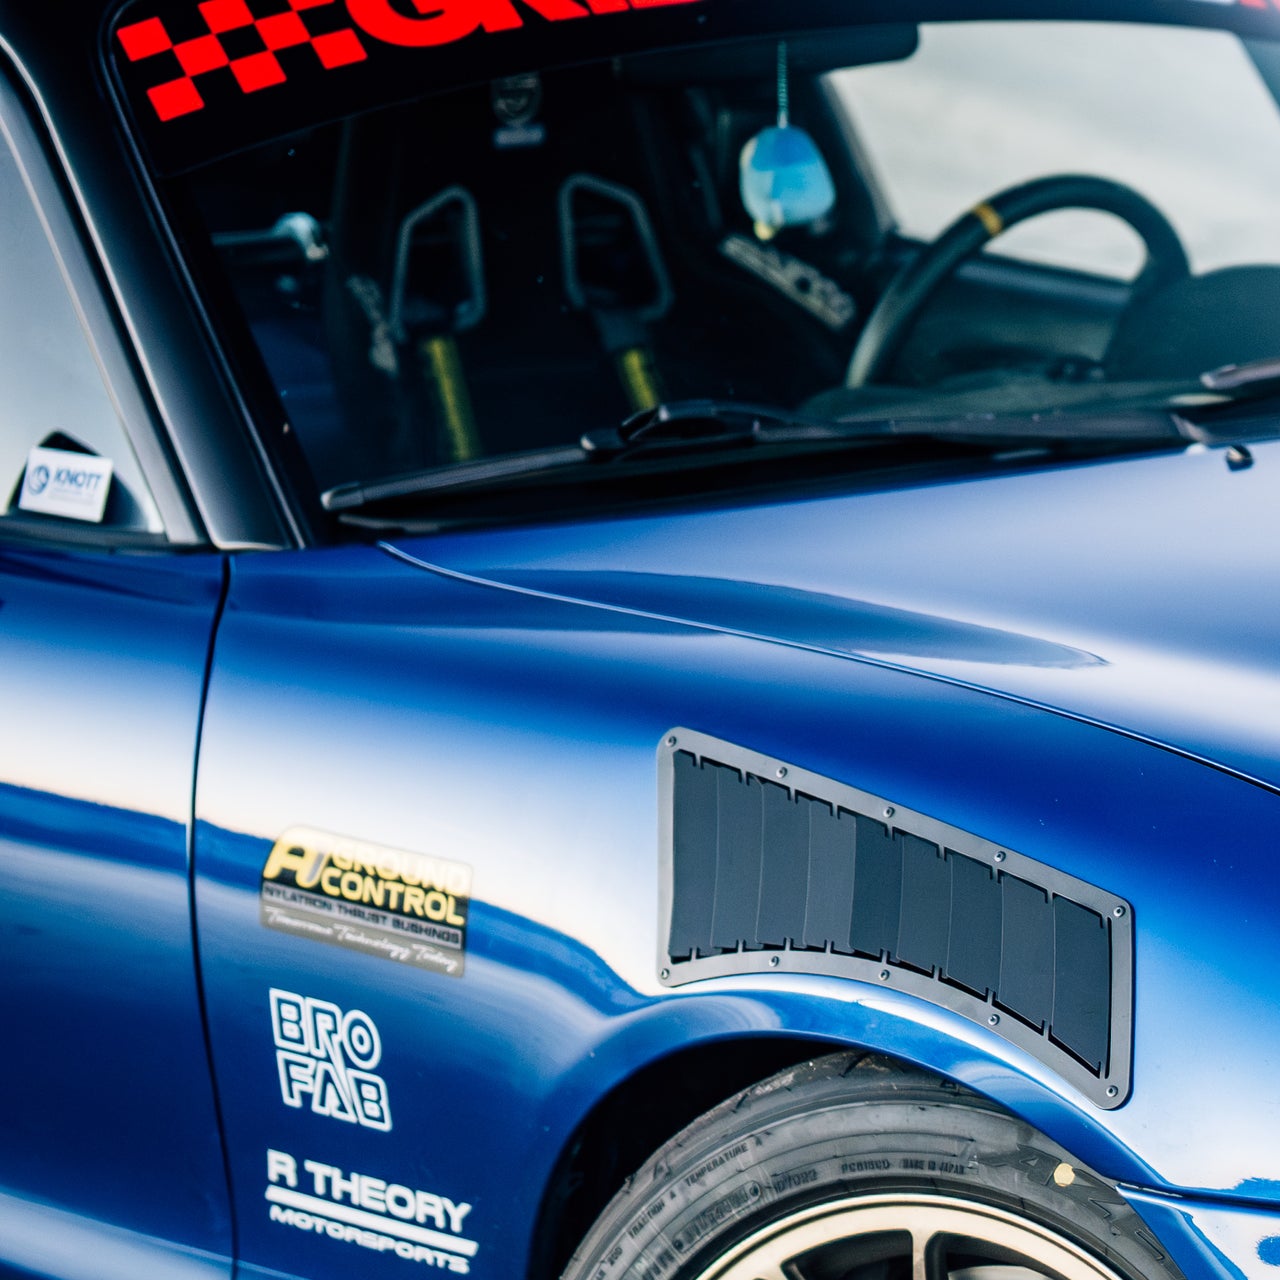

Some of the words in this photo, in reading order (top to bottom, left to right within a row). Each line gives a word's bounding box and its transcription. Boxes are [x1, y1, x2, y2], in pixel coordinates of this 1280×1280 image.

[55, 467, 103, 489] KNOTT
[321, 867, 466, 926] CONTROL
[330, 843, 467, 896] GROUND
[264, 881, 332, 911] NYLATRON
[336, 903, 388, 926] THRUST
[392, 916, 461, 945] BUSHINGS
[412, 944, 458, 972] Today
[269, 988, 382, 1071] BRO
[276, 1048, 392, 1132] FAB
[267, 1149, 298, 1188] R
[304, 1159, 472, 1233] THEORY
[684, 1143, 749, 1187] TEMPERATURE
[269, 1204, 470, 1275] MOTORSPORTS
